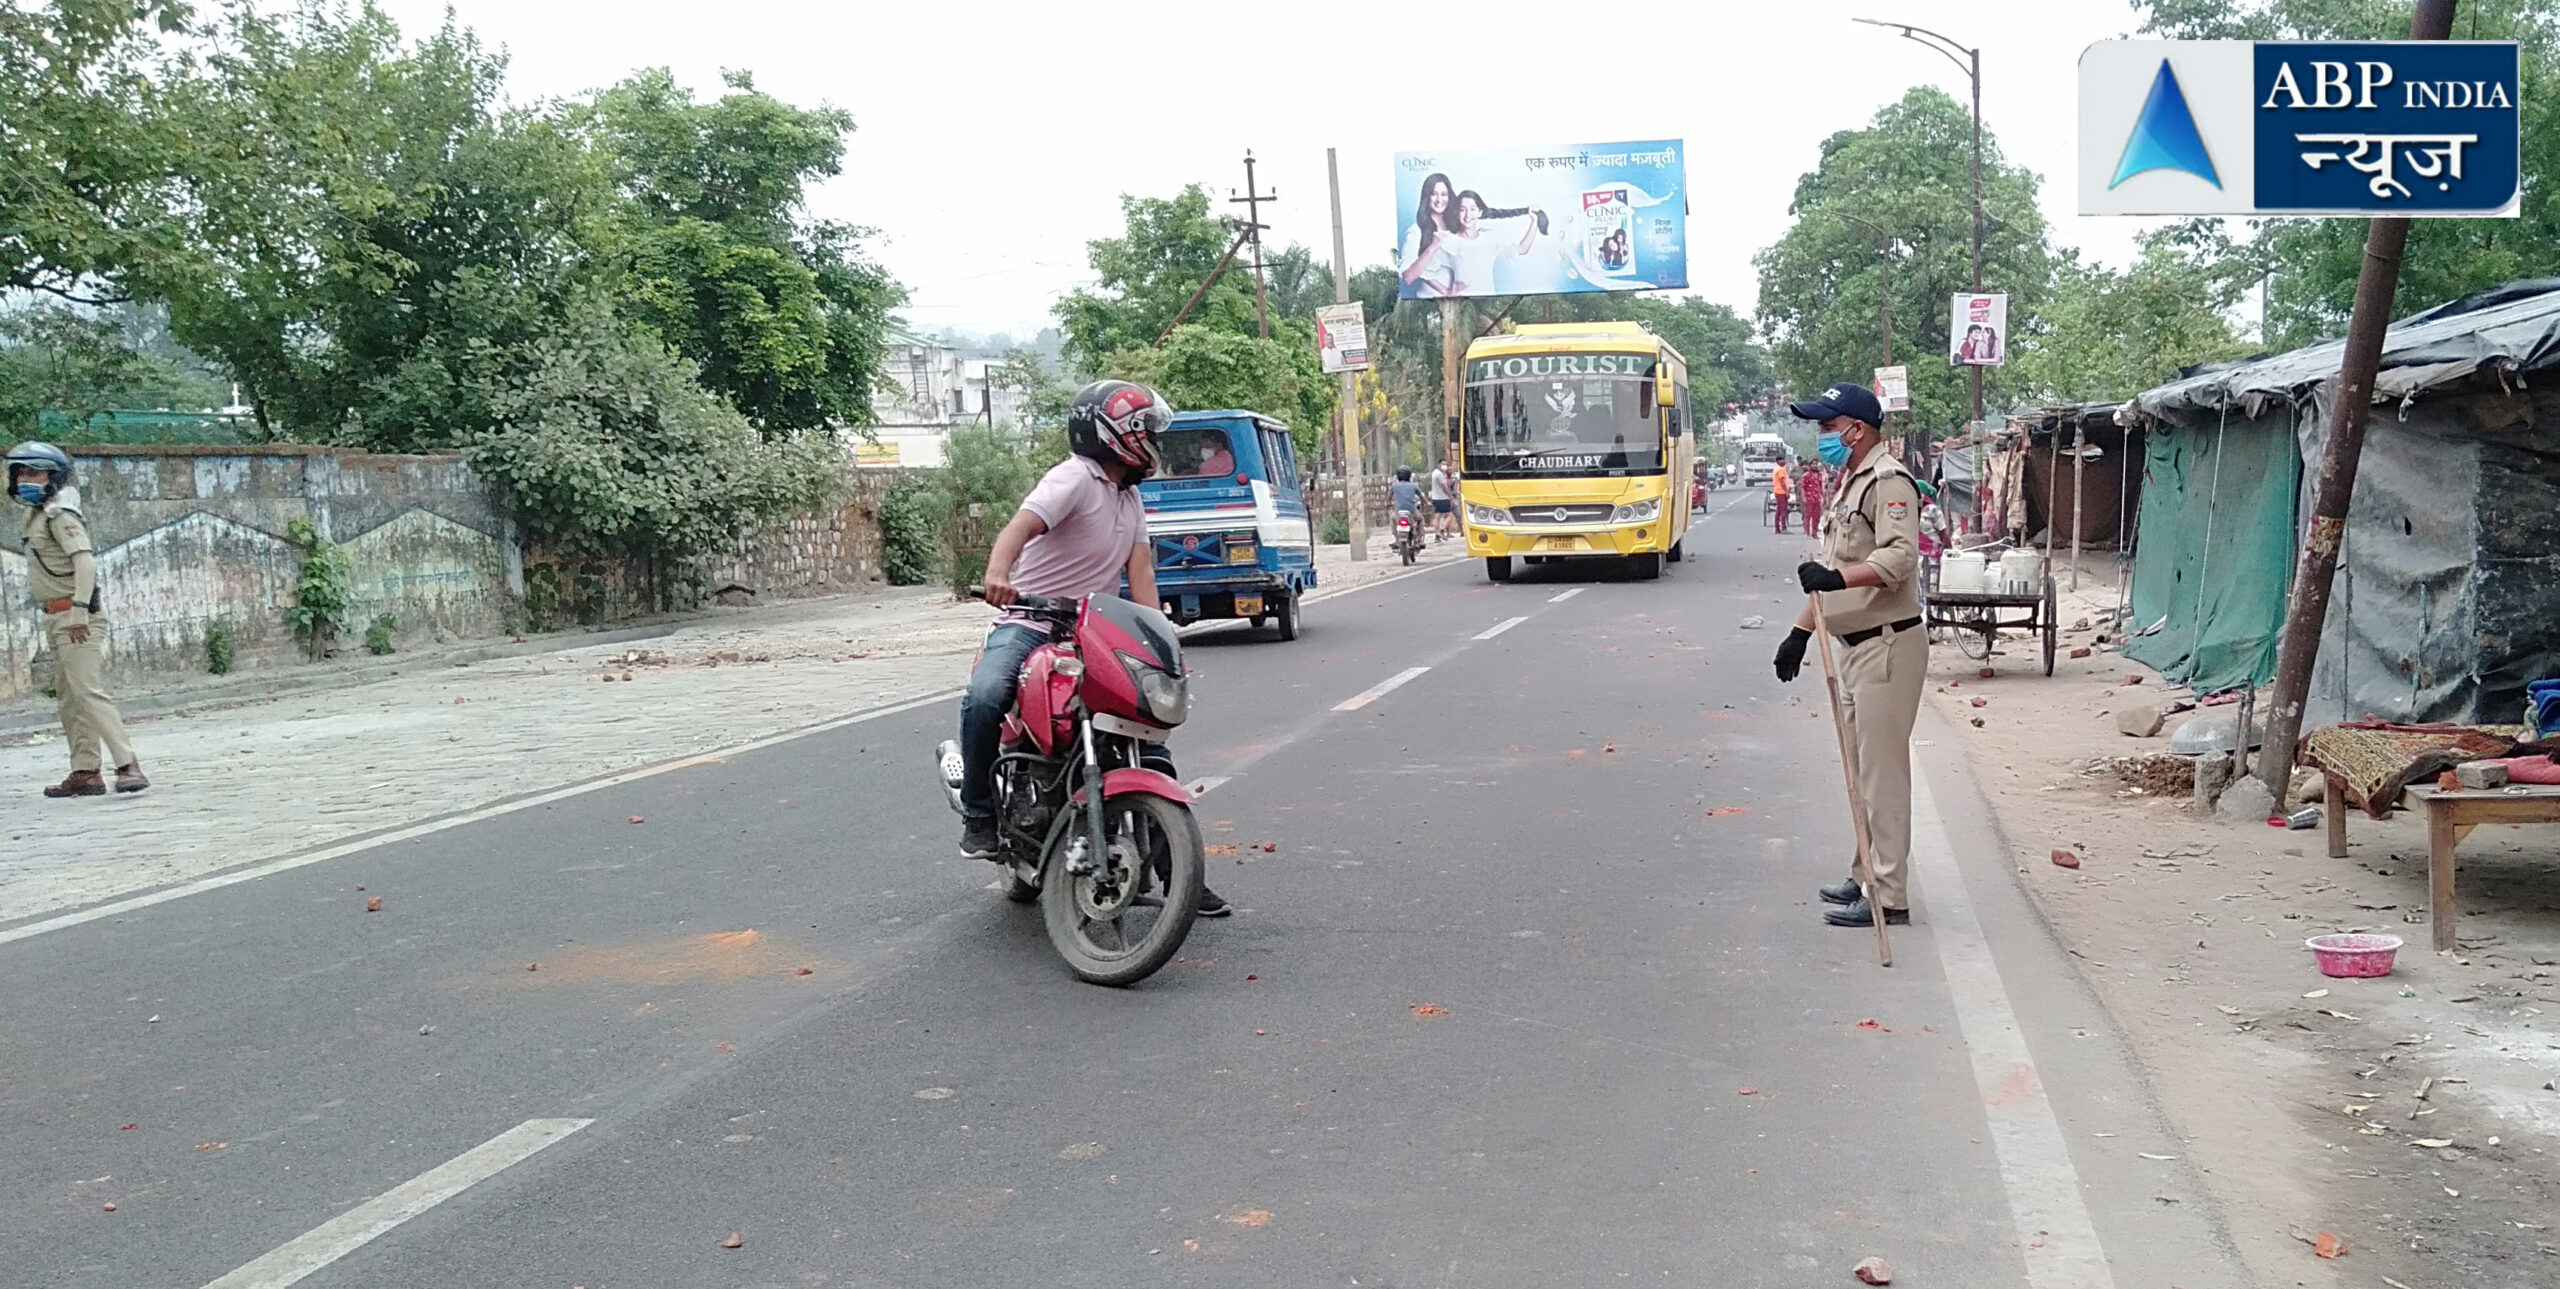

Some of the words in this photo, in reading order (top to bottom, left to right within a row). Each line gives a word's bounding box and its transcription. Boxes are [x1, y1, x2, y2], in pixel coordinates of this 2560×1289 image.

[1402, 157, 1437, 168] CLINIC
[1525, 157, 1545, 171] एक
[1579, 151, 1589, 167] में
[1586, 206, 1626, 218] CLINIC
[1480, 355, 1642, 379] TOURIST
[1519, 455, 1602, 468] CHAUDHARY
